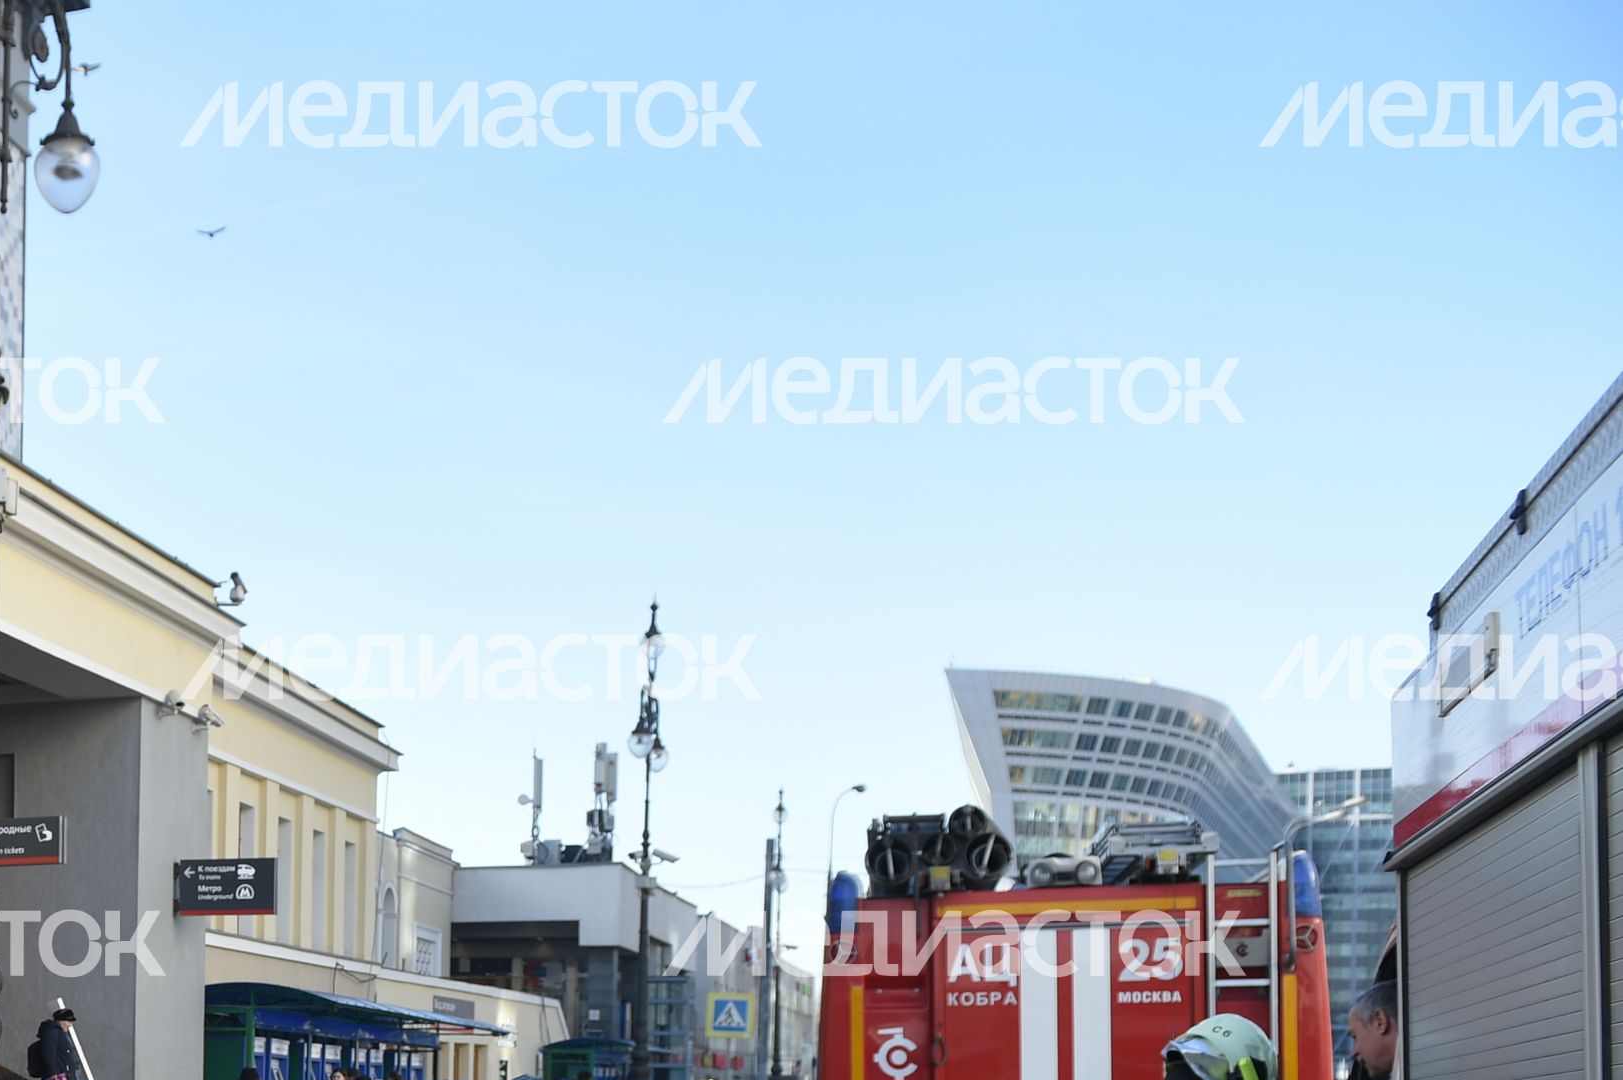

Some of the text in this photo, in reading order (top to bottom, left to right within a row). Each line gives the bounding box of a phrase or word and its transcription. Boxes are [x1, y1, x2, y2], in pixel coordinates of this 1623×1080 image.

[1515, 501, 1609, 640] ТЕЛЕФОН
[198, 885, 222, 893] Метро
[948, 942, 1018, 988] АЦ
[1118, 936, 1183, 982] 25
[947, 991, 1018, 1006] КОБРА
[1117, 990, 1182, 1004] МОСКВА
